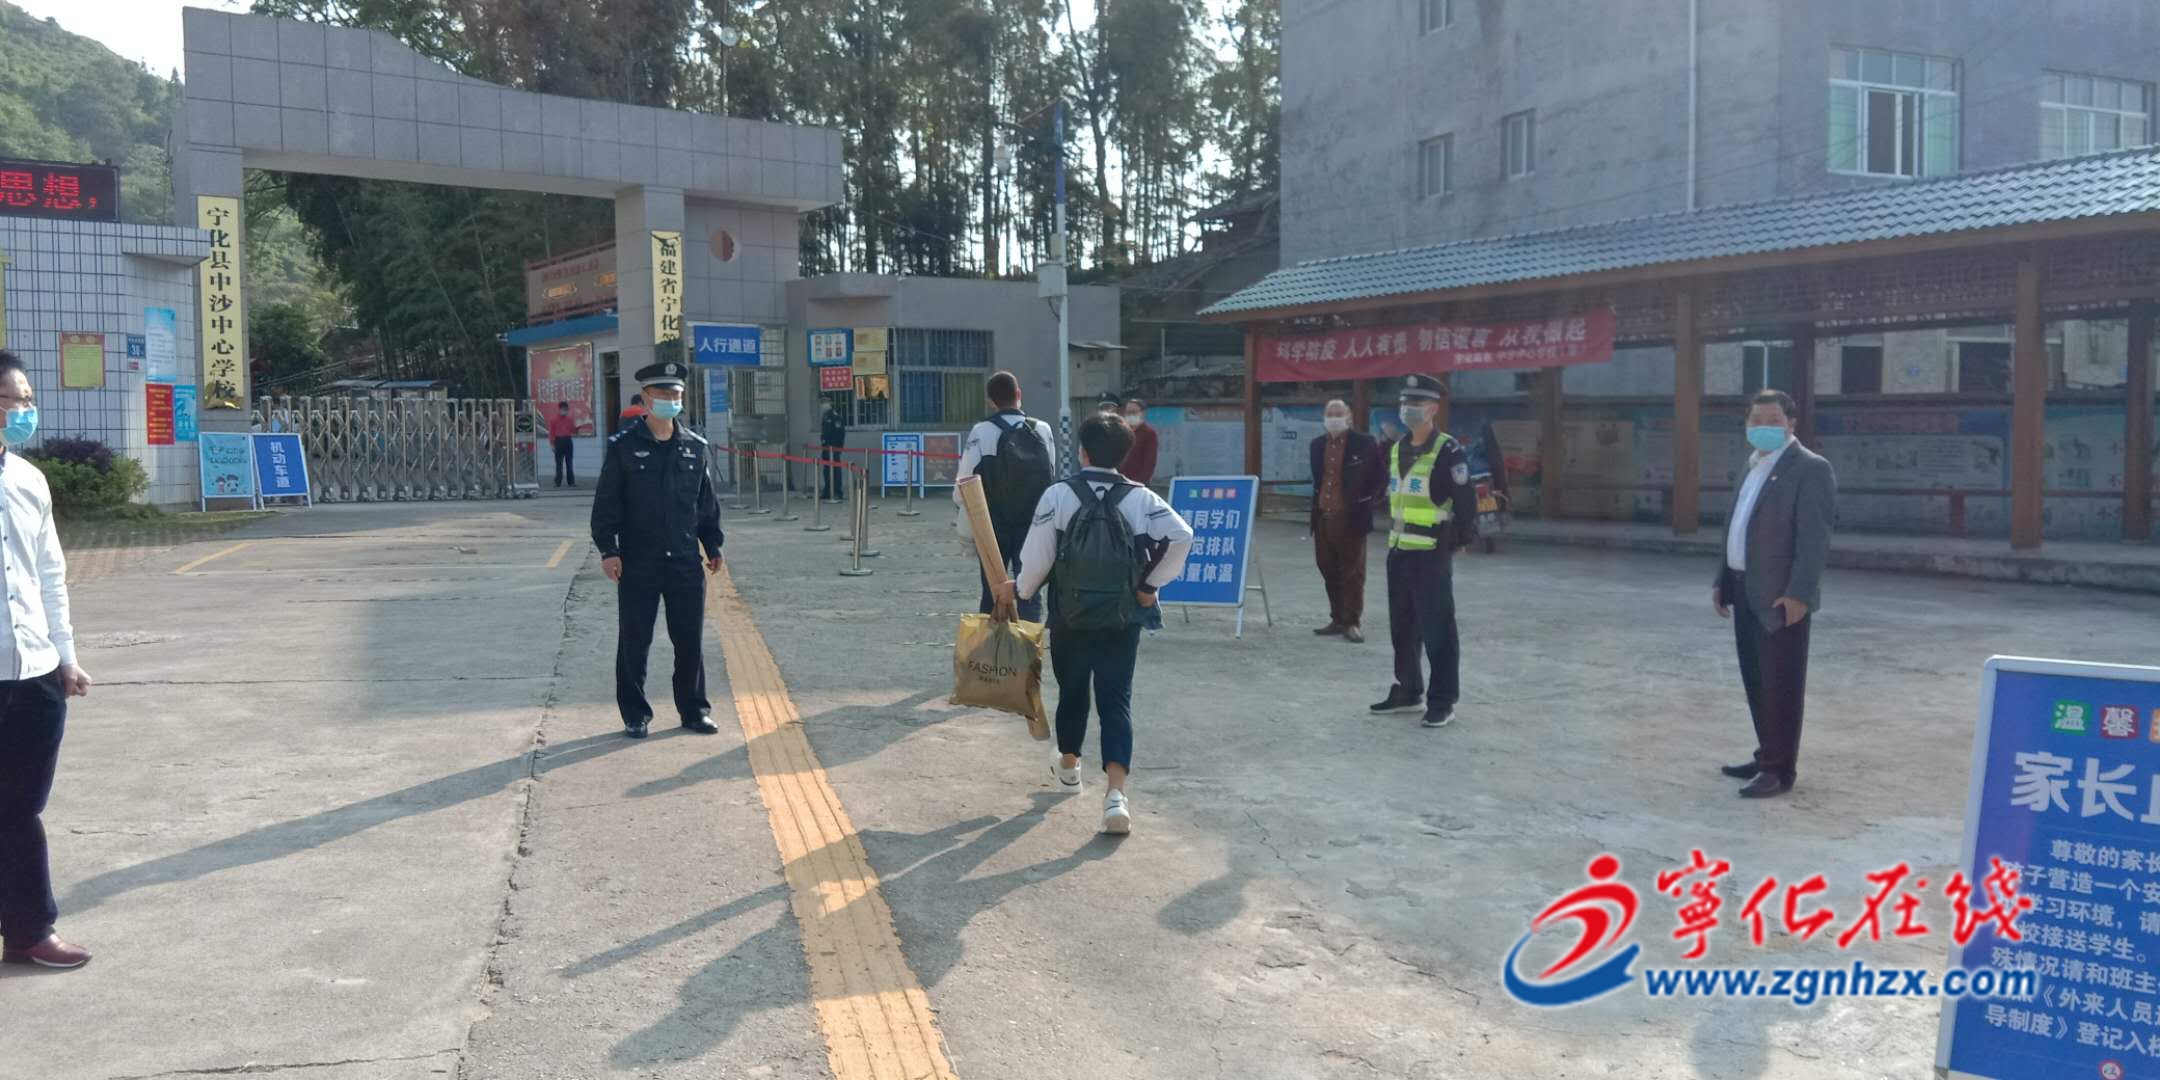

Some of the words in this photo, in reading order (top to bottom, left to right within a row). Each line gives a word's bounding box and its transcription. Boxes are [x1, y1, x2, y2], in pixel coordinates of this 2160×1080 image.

[206, 207, 235, 399] 宁化县中沙中心学校
[699, 337, 757, 354] 人行通道
[270, 441, 291, 489] 机动车道
[1190, 536, 1236, 556] 觉排队
[1174, 562, 1234, 583] 量体温
[967, 660, 1017, 677] FASHION
[1998, 893, 2160, 936] 学习环境，请
[2002, 920, 2146, 965] 校接送学生。
[1992, 945, 2160, 994] 殊情况请和班主
[2008, 985, 2160, 1027] 《外来人员
